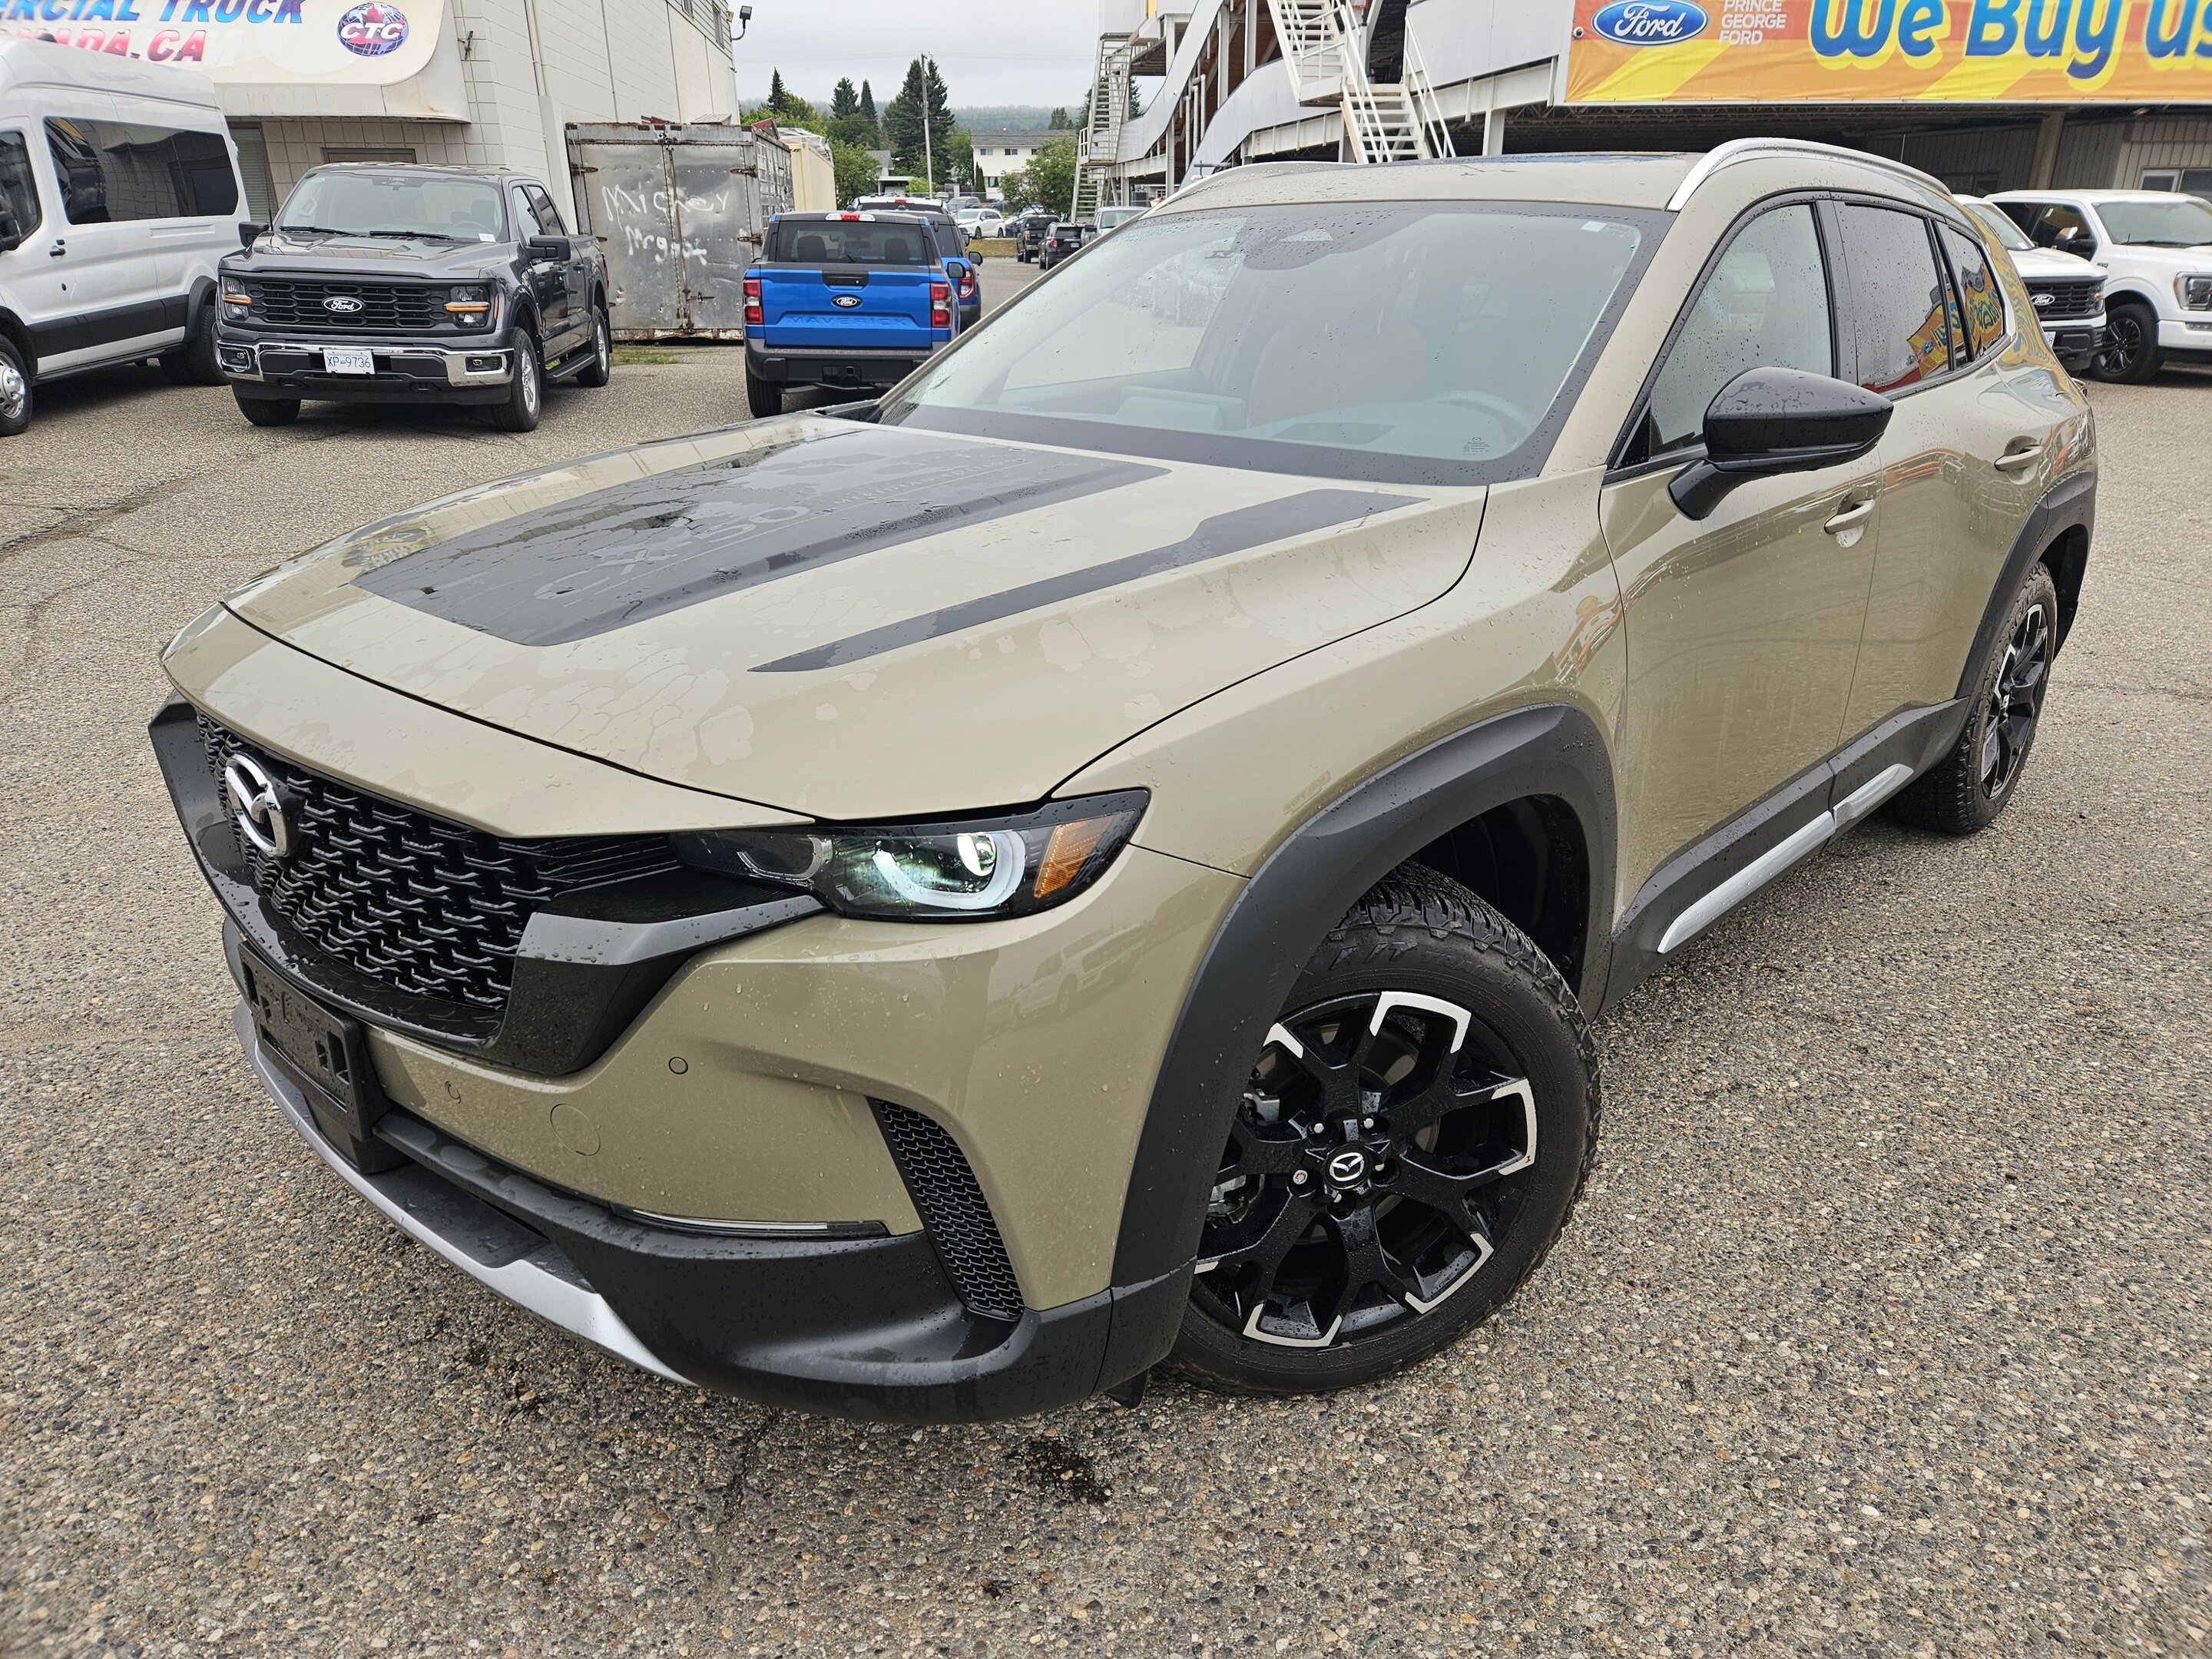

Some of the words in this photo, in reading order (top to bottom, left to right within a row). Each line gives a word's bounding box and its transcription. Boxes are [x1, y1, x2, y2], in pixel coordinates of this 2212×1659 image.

[159, 0, 303, 24] TRUCK
[1724, 0, 1783, 12] PRINCE
[1721, 14, 1787, 29] GEORGE
[340, 22, 403, 39] CTC
[1718, 30, 1763, 45] FORD
[1965, 0, 2117, 80] Buy
[790, 316, 908, 326] MAVERICK
